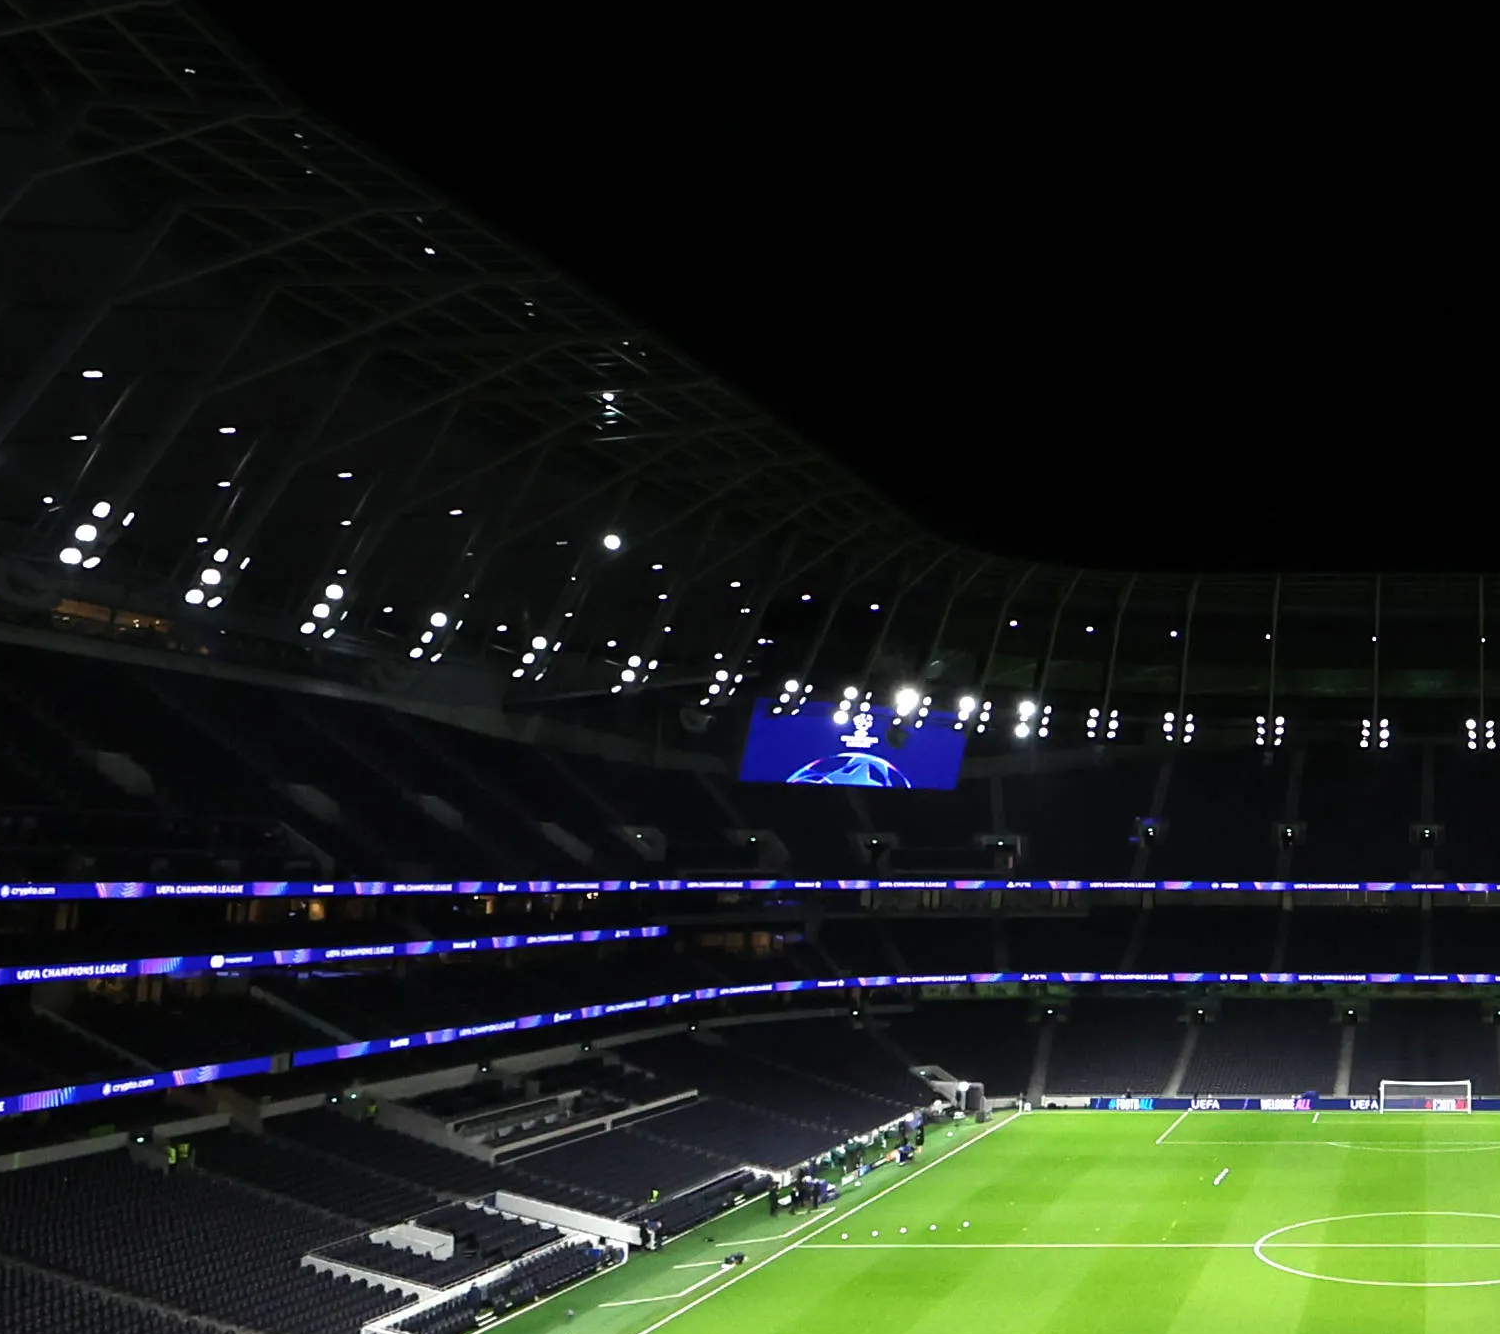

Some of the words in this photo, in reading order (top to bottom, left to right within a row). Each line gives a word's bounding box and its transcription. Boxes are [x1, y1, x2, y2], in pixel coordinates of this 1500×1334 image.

[17, 970, 40, 980] UEFA
[42, 966, 94, 978] CHAMPIONS
[95, 964, 127, 974] LEAGUE
[113, 1079, 153, 1091] crypto.com
[1191, 1099, 1220, 1110] UEFA
[1350, 1099, 1379, 1110] UEFA
